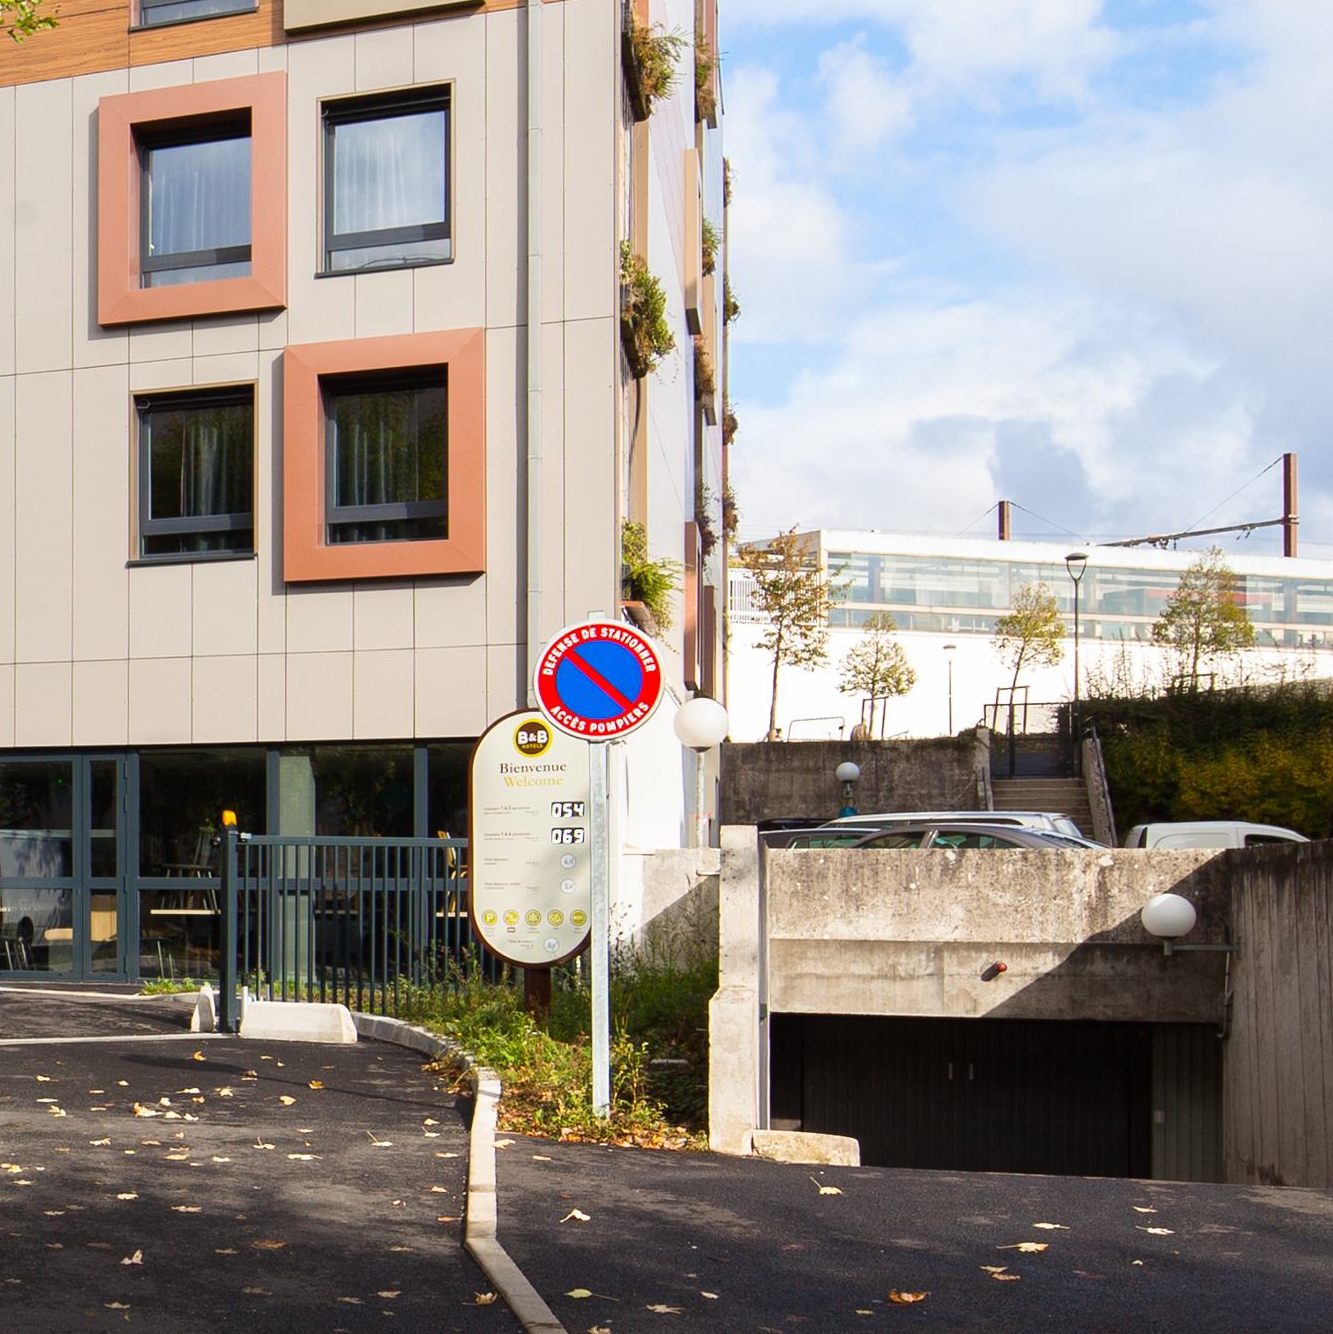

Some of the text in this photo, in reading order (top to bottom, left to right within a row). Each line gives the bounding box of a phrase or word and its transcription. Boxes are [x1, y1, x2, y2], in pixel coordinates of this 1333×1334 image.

[542, 627, 656, 676] DEFENSE DE STATIONNER
[550, 702, 649, 733] ACCÈS POMPIERS
[518, 730, 548, 745] B&B
[500, 763, 567, 774] Bienvenue
[503, 776, 564, 787] Welcome
